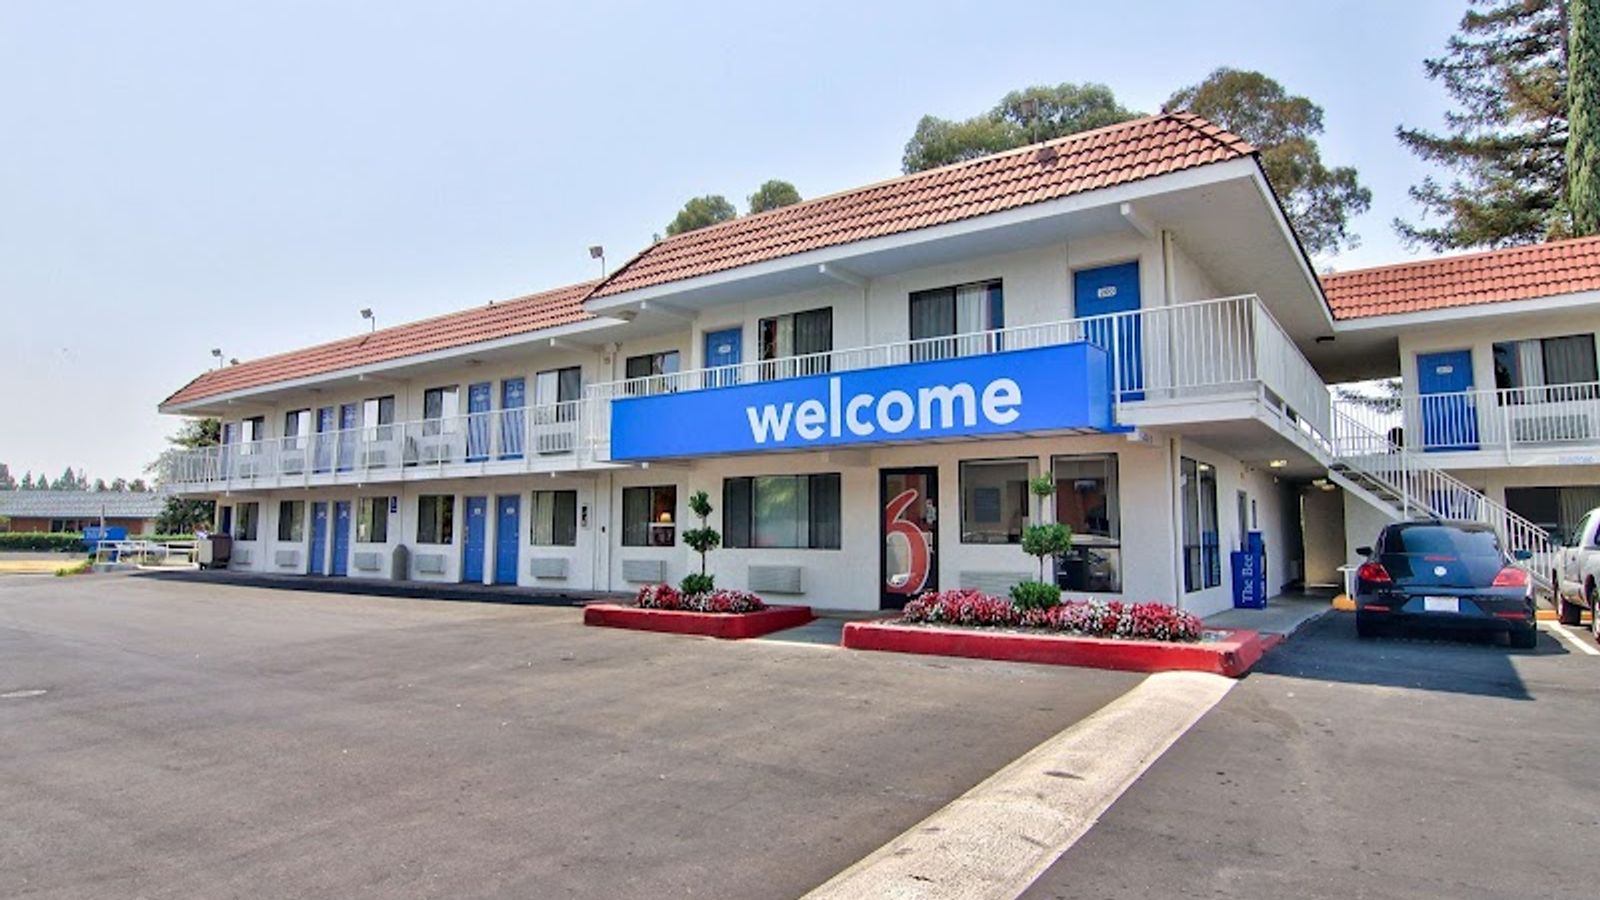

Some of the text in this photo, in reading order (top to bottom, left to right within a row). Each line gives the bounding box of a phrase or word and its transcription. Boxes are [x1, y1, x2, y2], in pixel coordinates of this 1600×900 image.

[746, 377, 1022, 444] welcome
[886, 489, 930, 595] 6
[1241, 554, 1253, 603] The Bee
